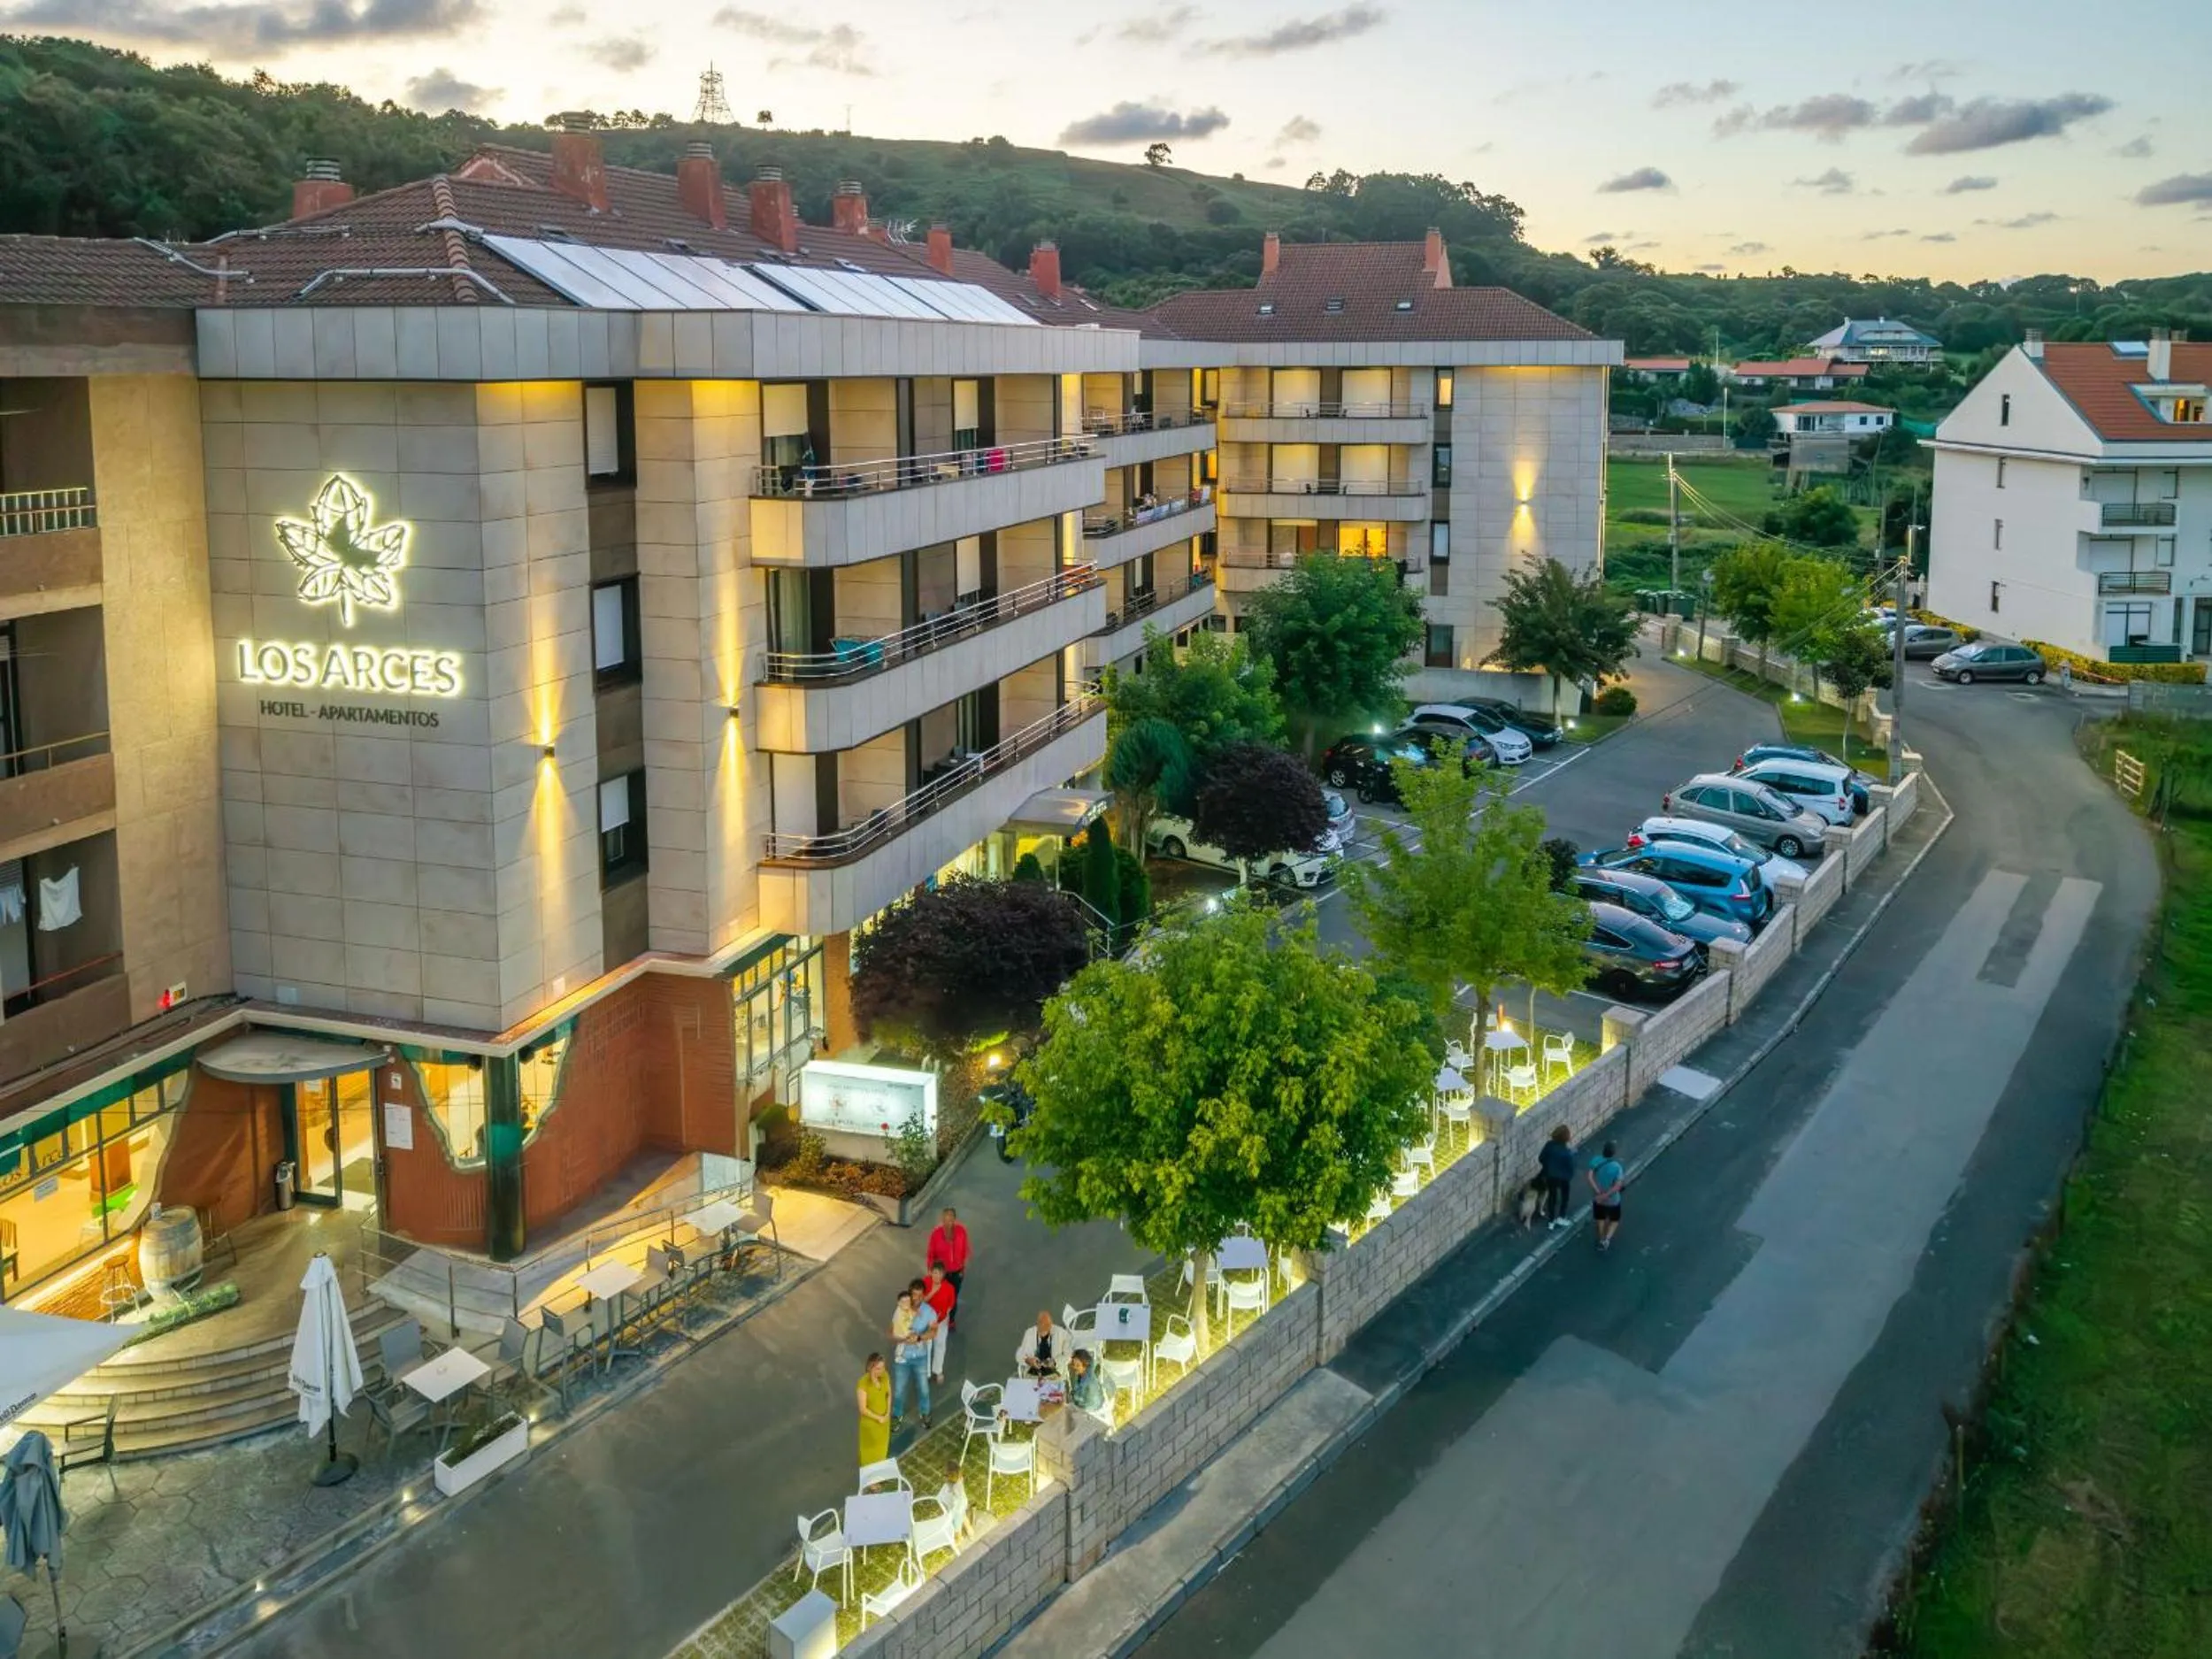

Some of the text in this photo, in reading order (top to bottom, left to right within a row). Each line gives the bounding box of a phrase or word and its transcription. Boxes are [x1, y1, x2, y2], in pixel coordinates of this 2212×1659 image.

[238, 641, 459, 695] LOS ARCES
[259, 699, 309, 718] HOTEL
[318, 703, 440, 728] APARTAMENTOS
